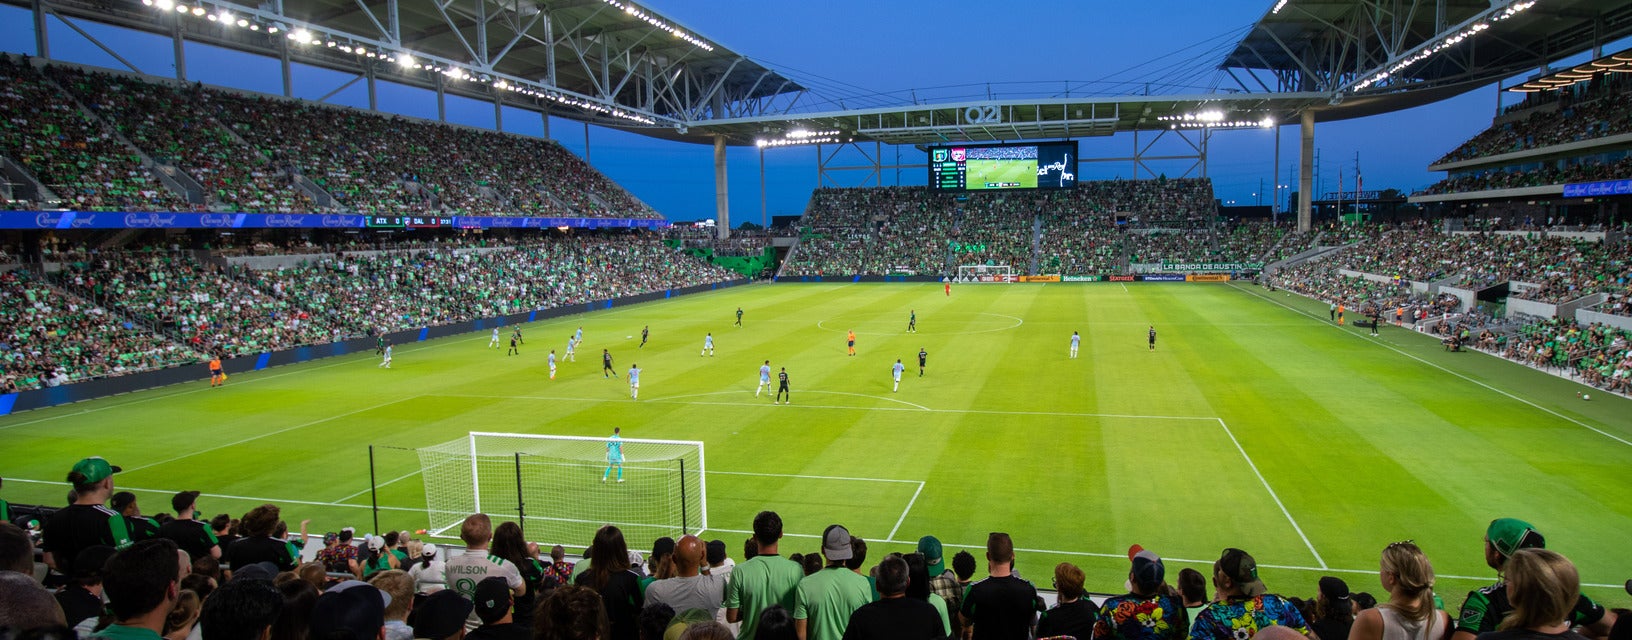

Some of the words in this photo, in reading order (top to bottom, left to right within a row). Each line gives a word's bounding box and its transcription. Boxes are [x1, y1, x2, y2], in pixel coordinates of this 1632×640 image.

[125, 212, 150, 227] Crown
[144, 213, 176, 227] Royal
[376, 217, 387, 225] ATX
[450, 565, 488, 575] WILSON
